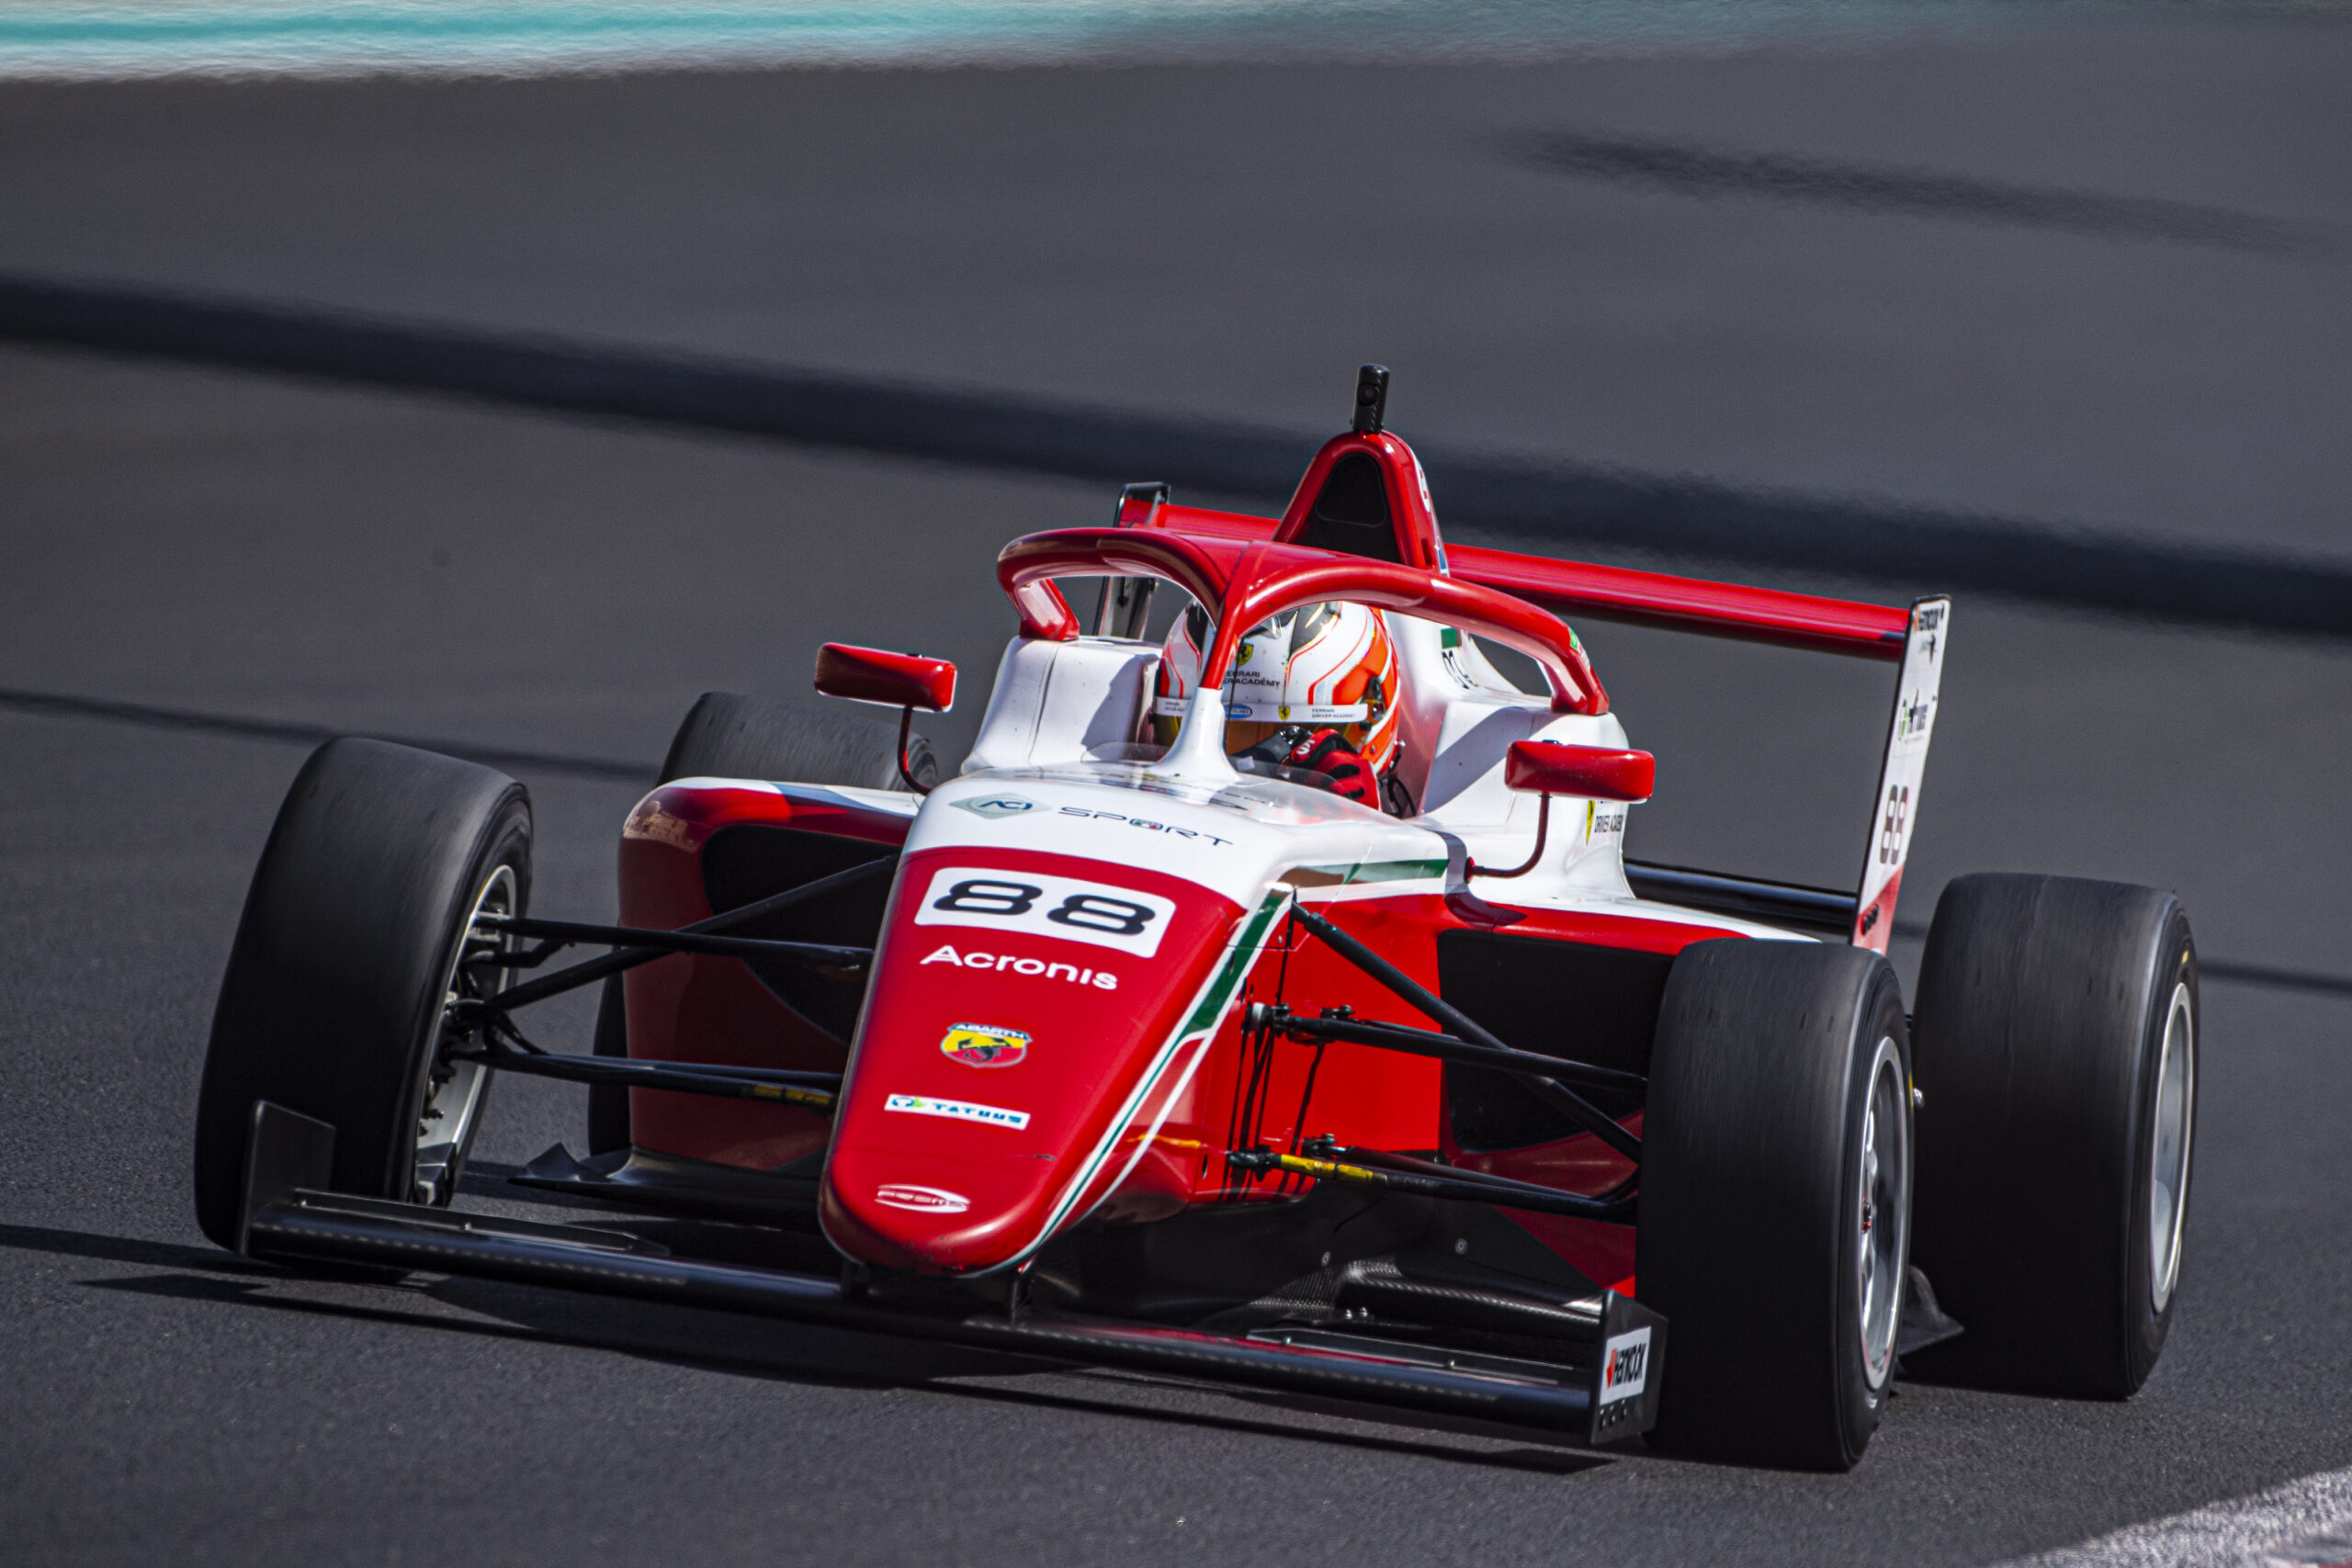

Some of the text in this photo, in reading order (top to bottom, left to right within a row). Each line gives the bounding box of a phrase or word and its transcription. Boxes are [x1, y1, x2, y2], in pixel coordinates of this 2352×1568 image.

[1057, 807, 1234, 846] SPORT
[1880, 784, 1908, 865] 88
[933, 879, 1156, 935] 88
[920, 945, 1118, 990] Acronis
[955, 1022, 1025, 1040] ABARTH
[933, 1101, 1023, 1123] TATUUS
